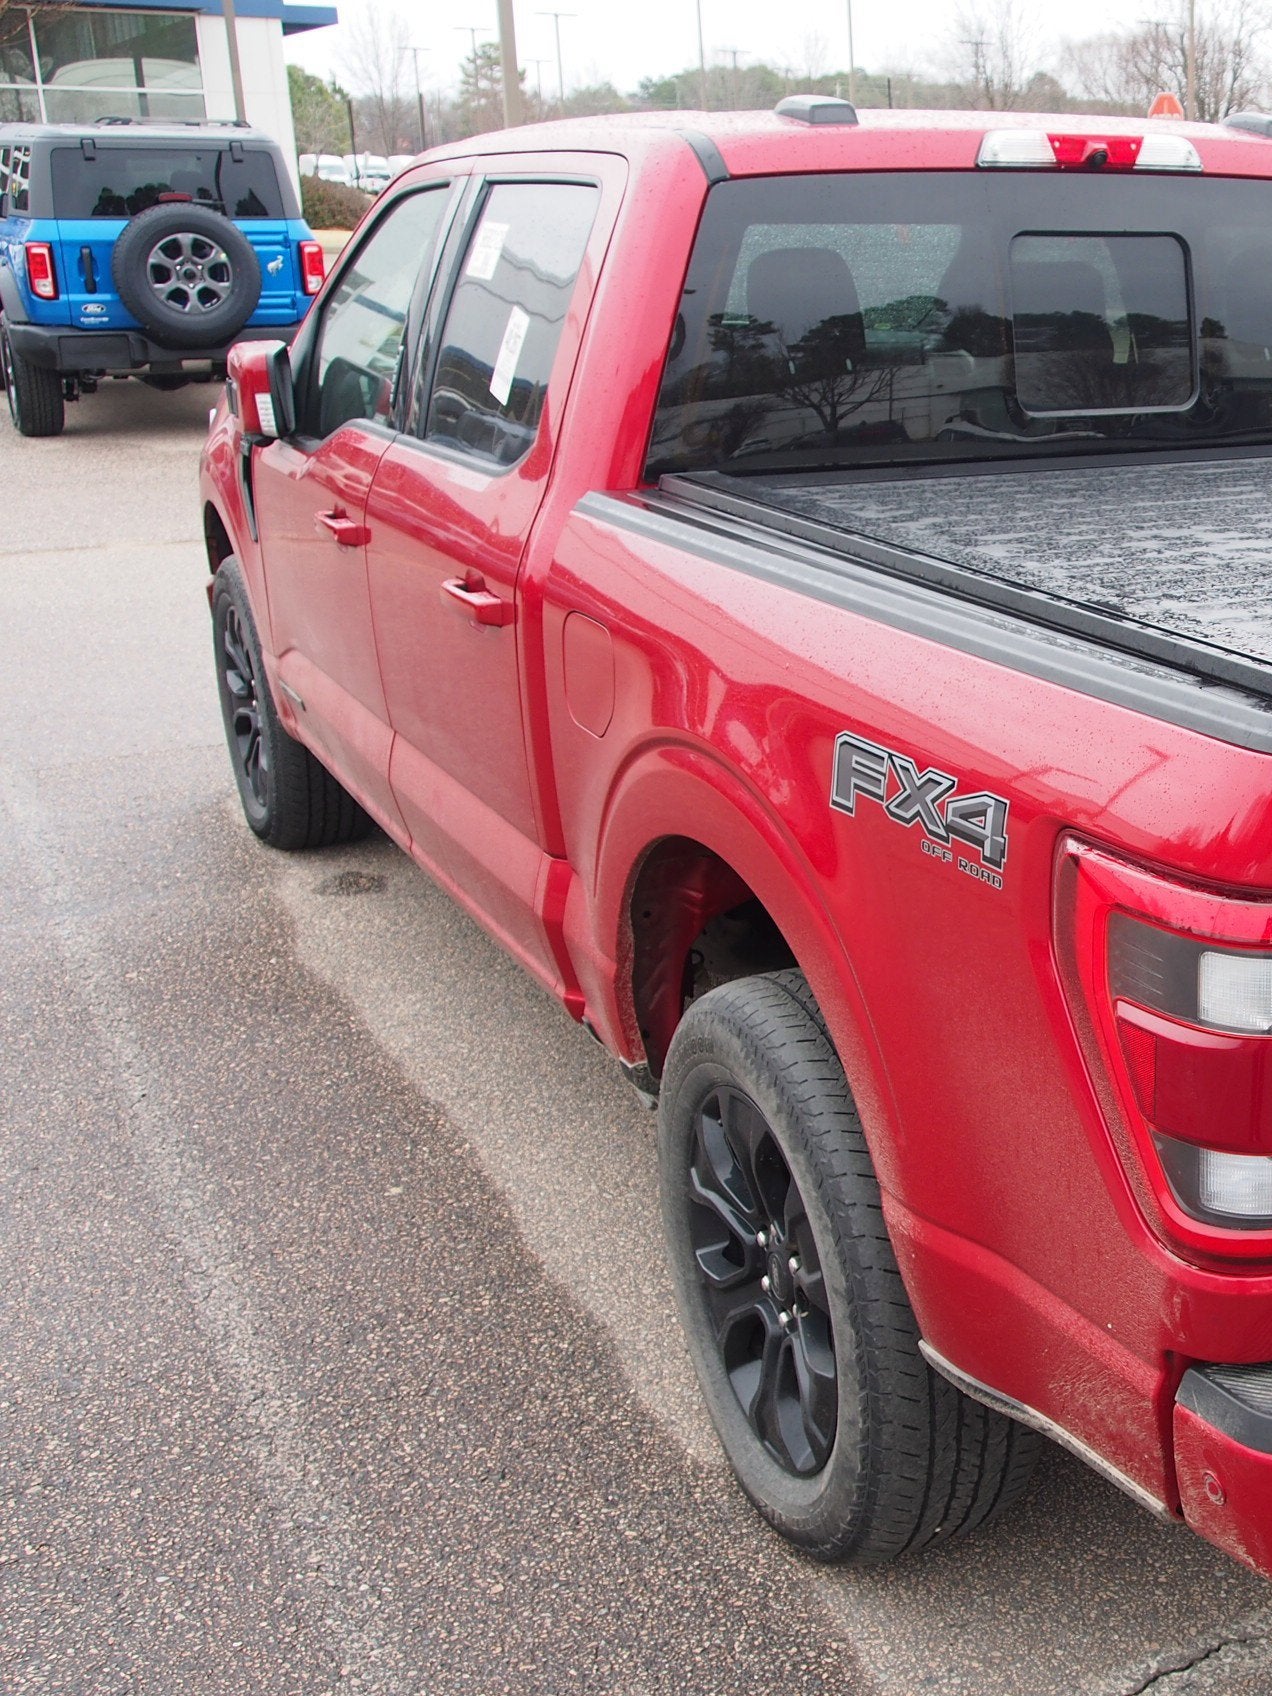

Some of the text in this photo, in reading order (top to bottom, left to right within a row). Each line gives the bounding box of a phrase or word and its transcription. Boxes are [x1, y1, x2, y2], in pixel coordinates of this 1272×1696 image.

[829, 730, 1010, 872] FX4
[920, 838, 1003, 890] OFF ROAD
